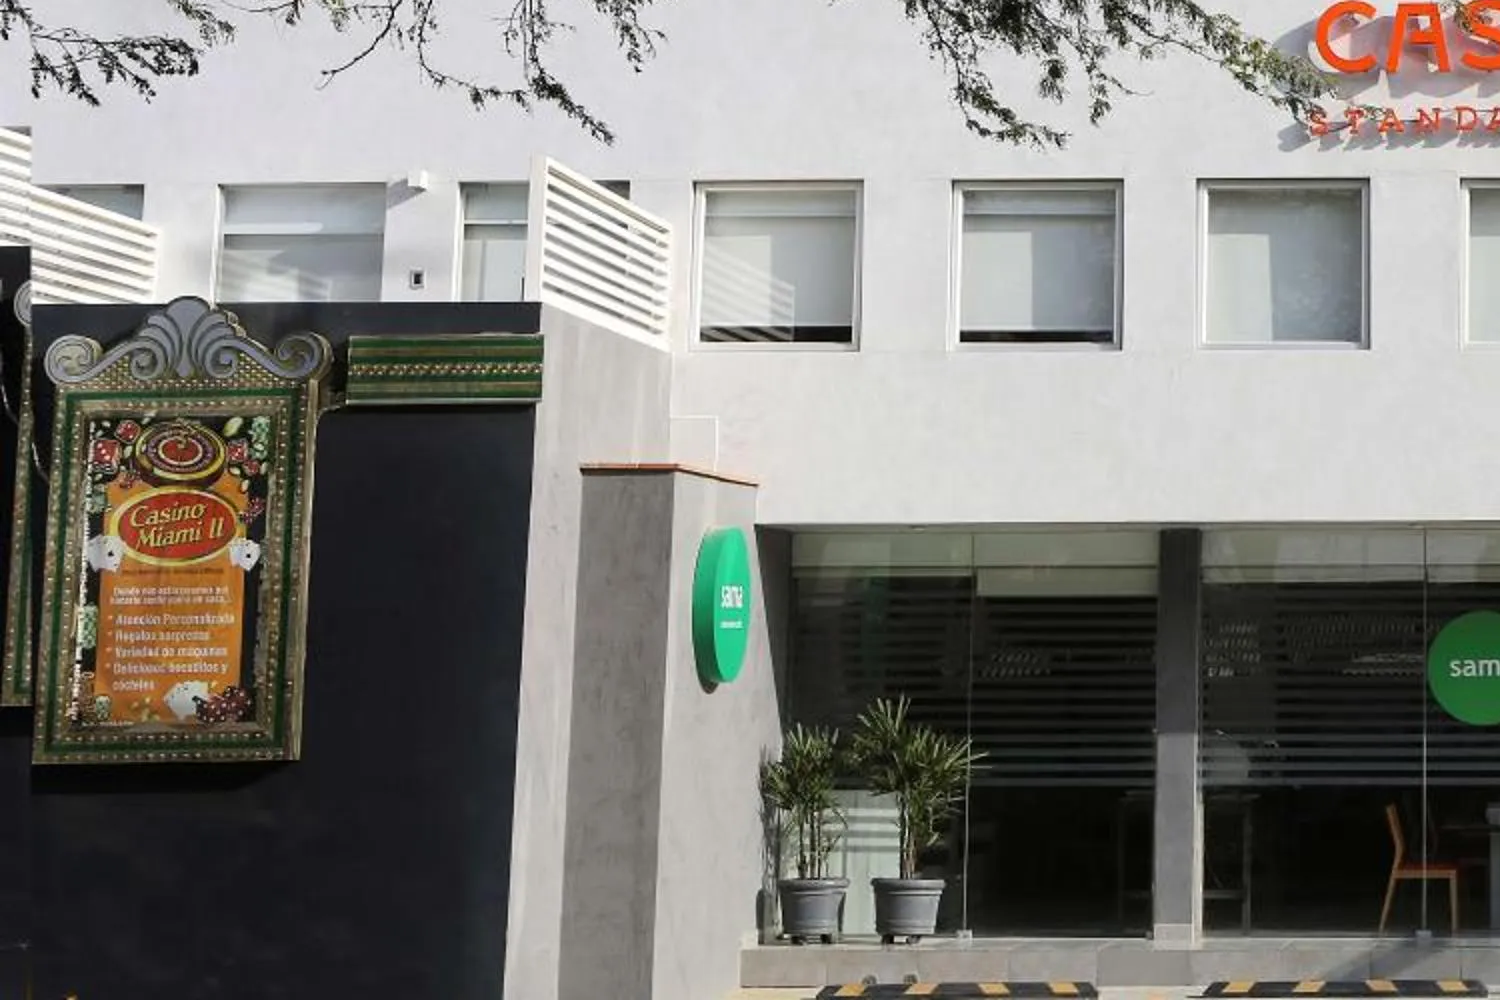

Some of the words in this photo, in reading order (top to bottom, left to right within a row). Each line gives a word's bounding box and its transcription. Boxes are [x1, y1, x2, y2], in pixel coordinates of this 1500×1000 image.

[129, 501, 206, 528] Casino
[135, 521, 202, 550] Miami
[720, 585, 744, 608] sama
